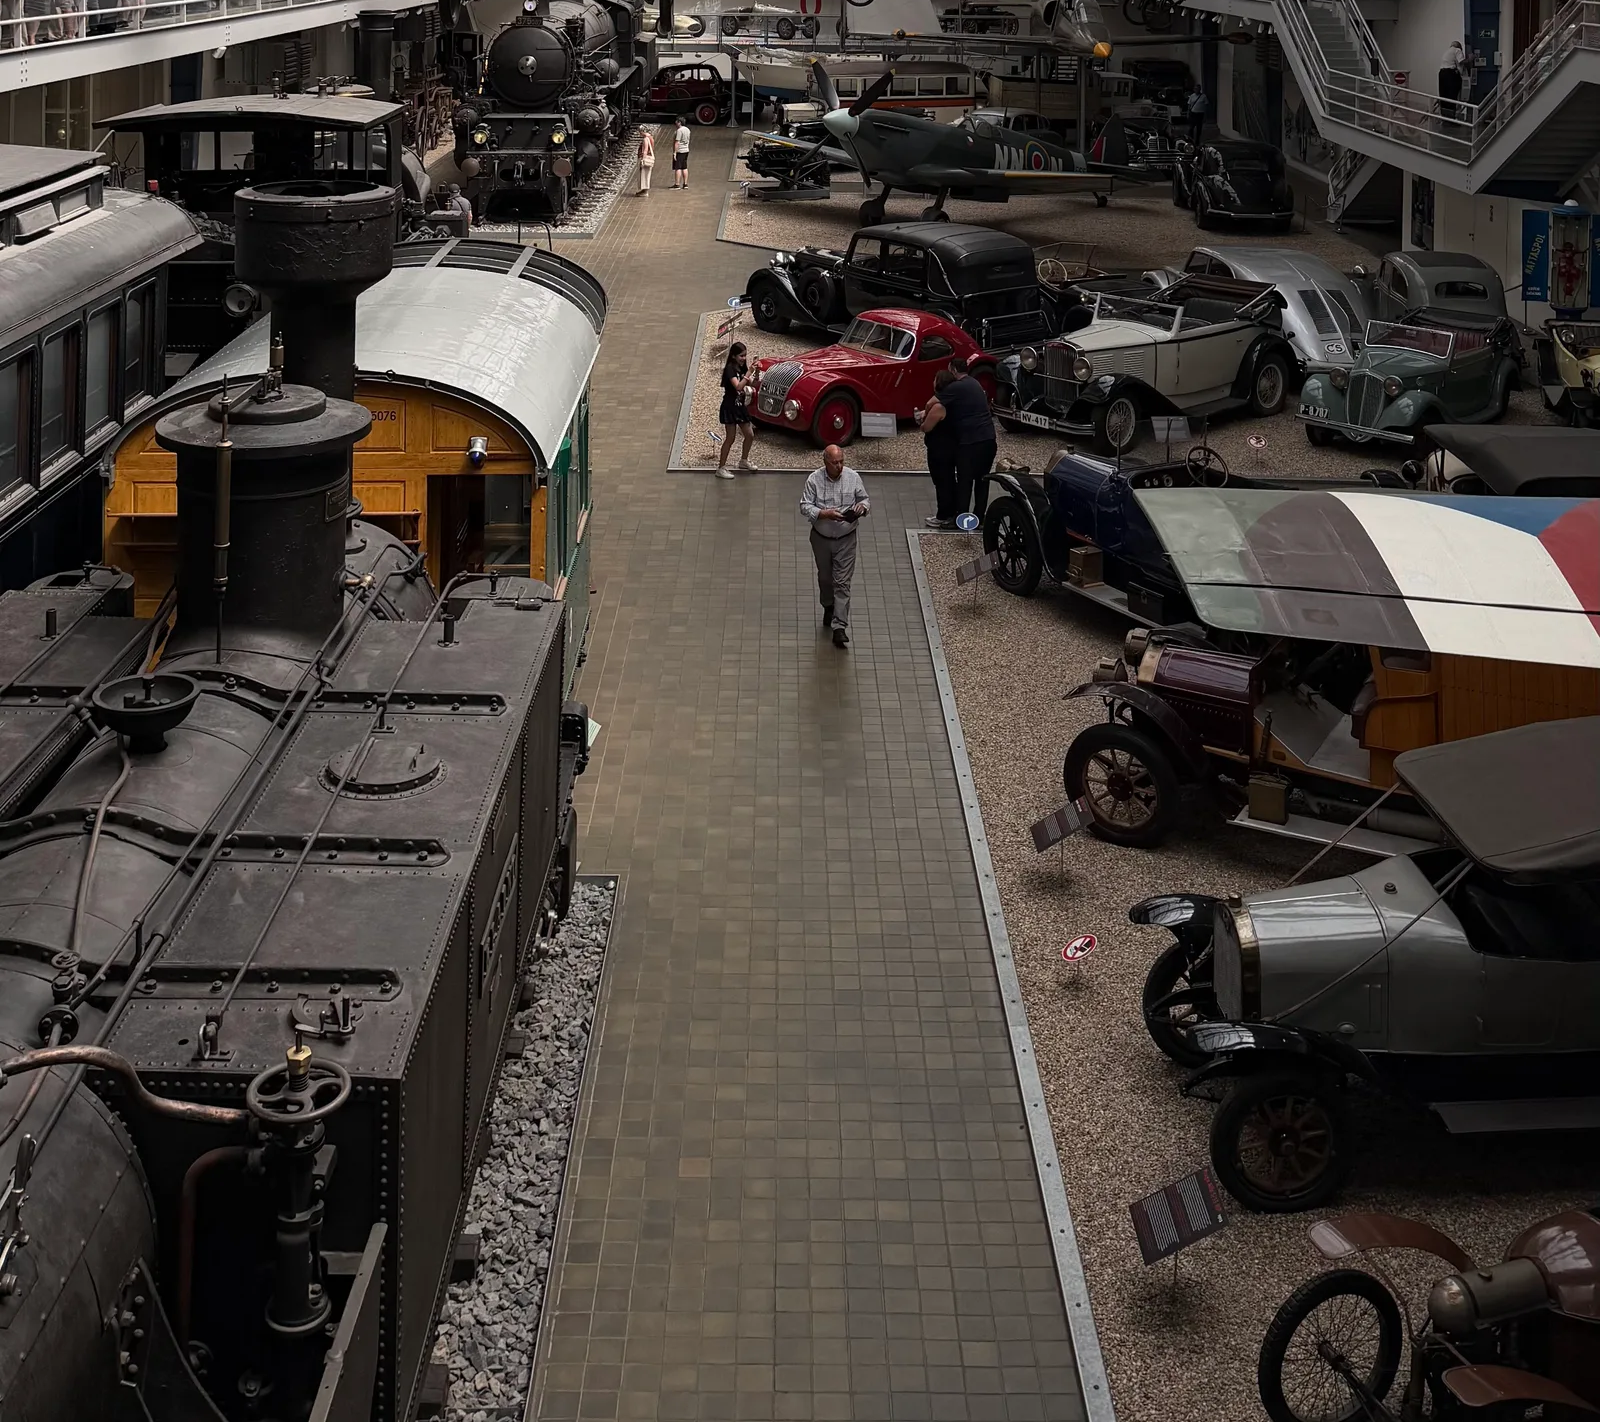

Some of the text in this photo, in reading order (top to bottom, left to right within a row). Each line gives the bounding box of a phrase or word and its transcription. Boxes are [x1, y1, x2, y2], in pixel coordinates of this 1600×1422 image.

[994, 143, 1024, 171] NN
[1525, 233, 1546, 275] NAFTASPOL
[1326, 343, 1343, 352] CS
[371, 410, 397, 421] 5076
